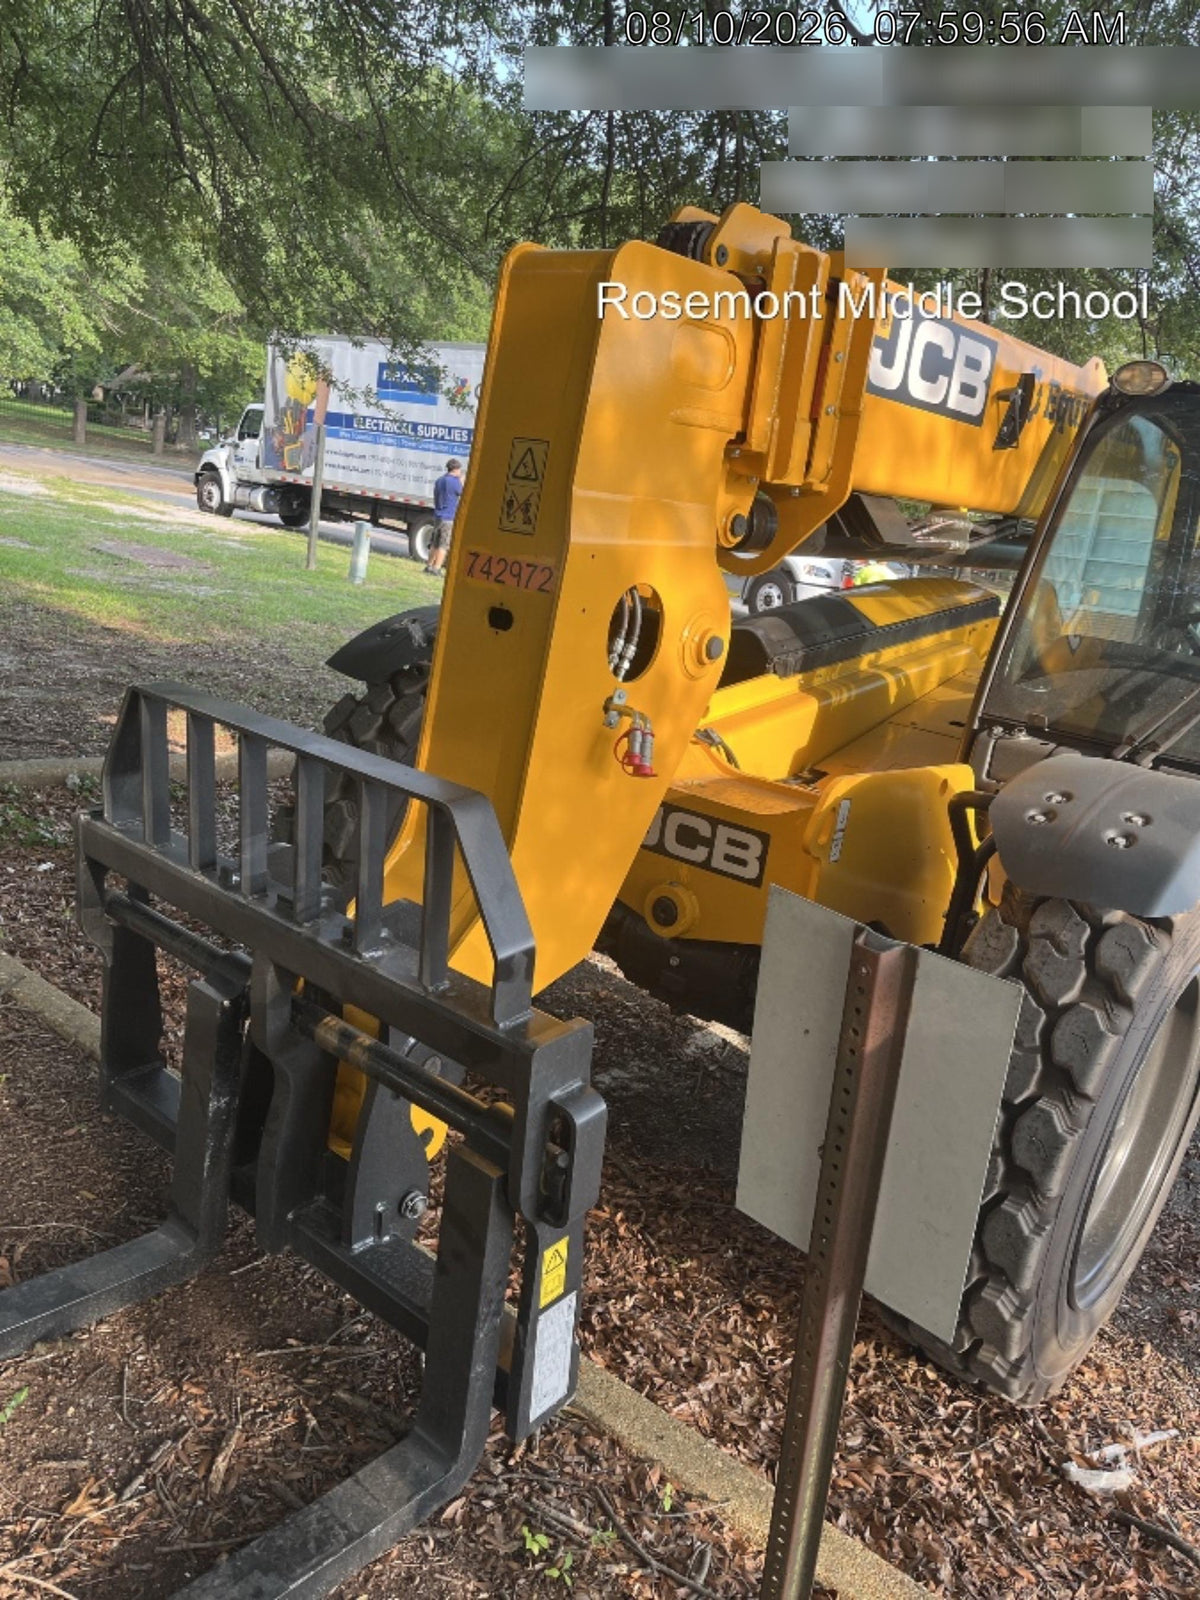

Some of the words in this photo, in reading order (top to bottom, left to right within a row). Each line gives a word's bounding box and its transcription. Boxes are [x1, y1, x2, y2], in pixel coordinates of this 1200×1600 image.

[868, 308, 993, 417] JCB
[417, 424, 468, 441] SUPPLIES
[467, 552, 555, 593] 742972
